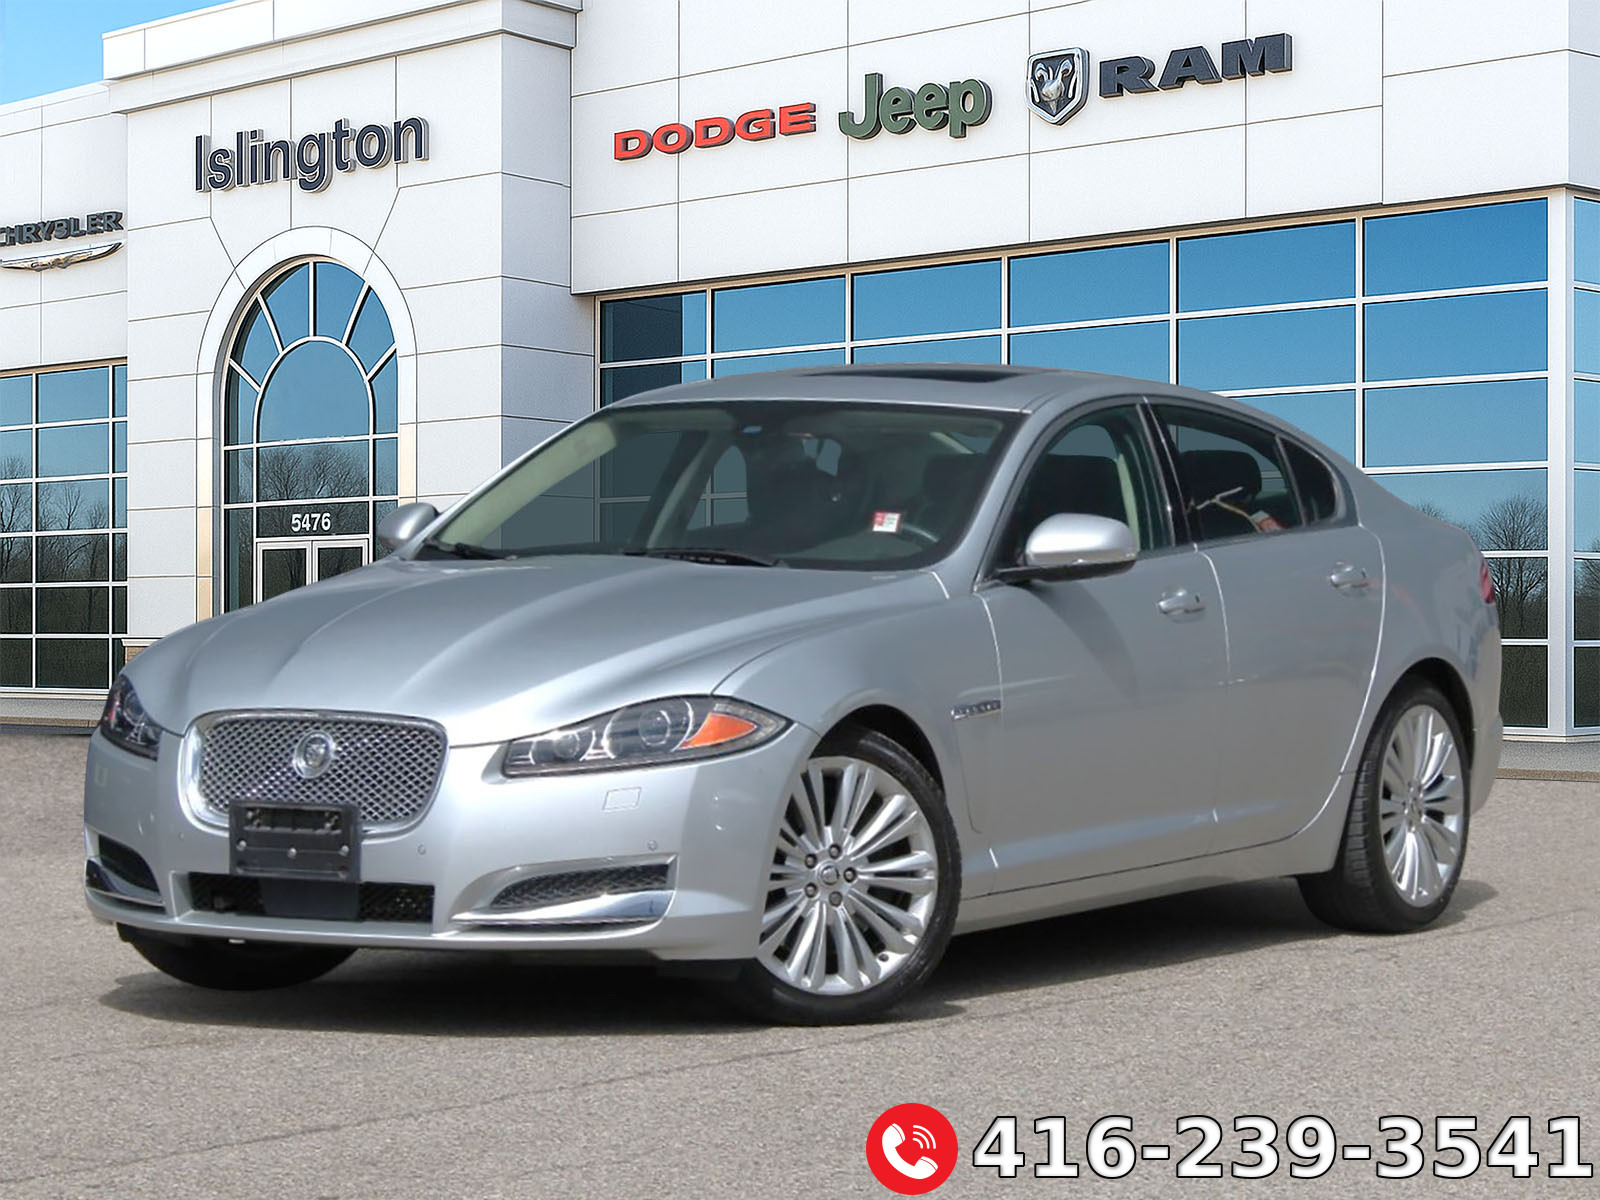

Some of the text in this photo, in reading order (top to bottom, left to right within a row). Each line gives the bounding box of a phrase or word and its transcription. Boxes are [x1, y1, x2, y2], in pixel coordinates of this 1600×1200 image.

[614, 33, 1292, 161] DODGE Jeep RAM
[195, 116, 430, 192] Islington
[291, 512, 331, 532] 5476
